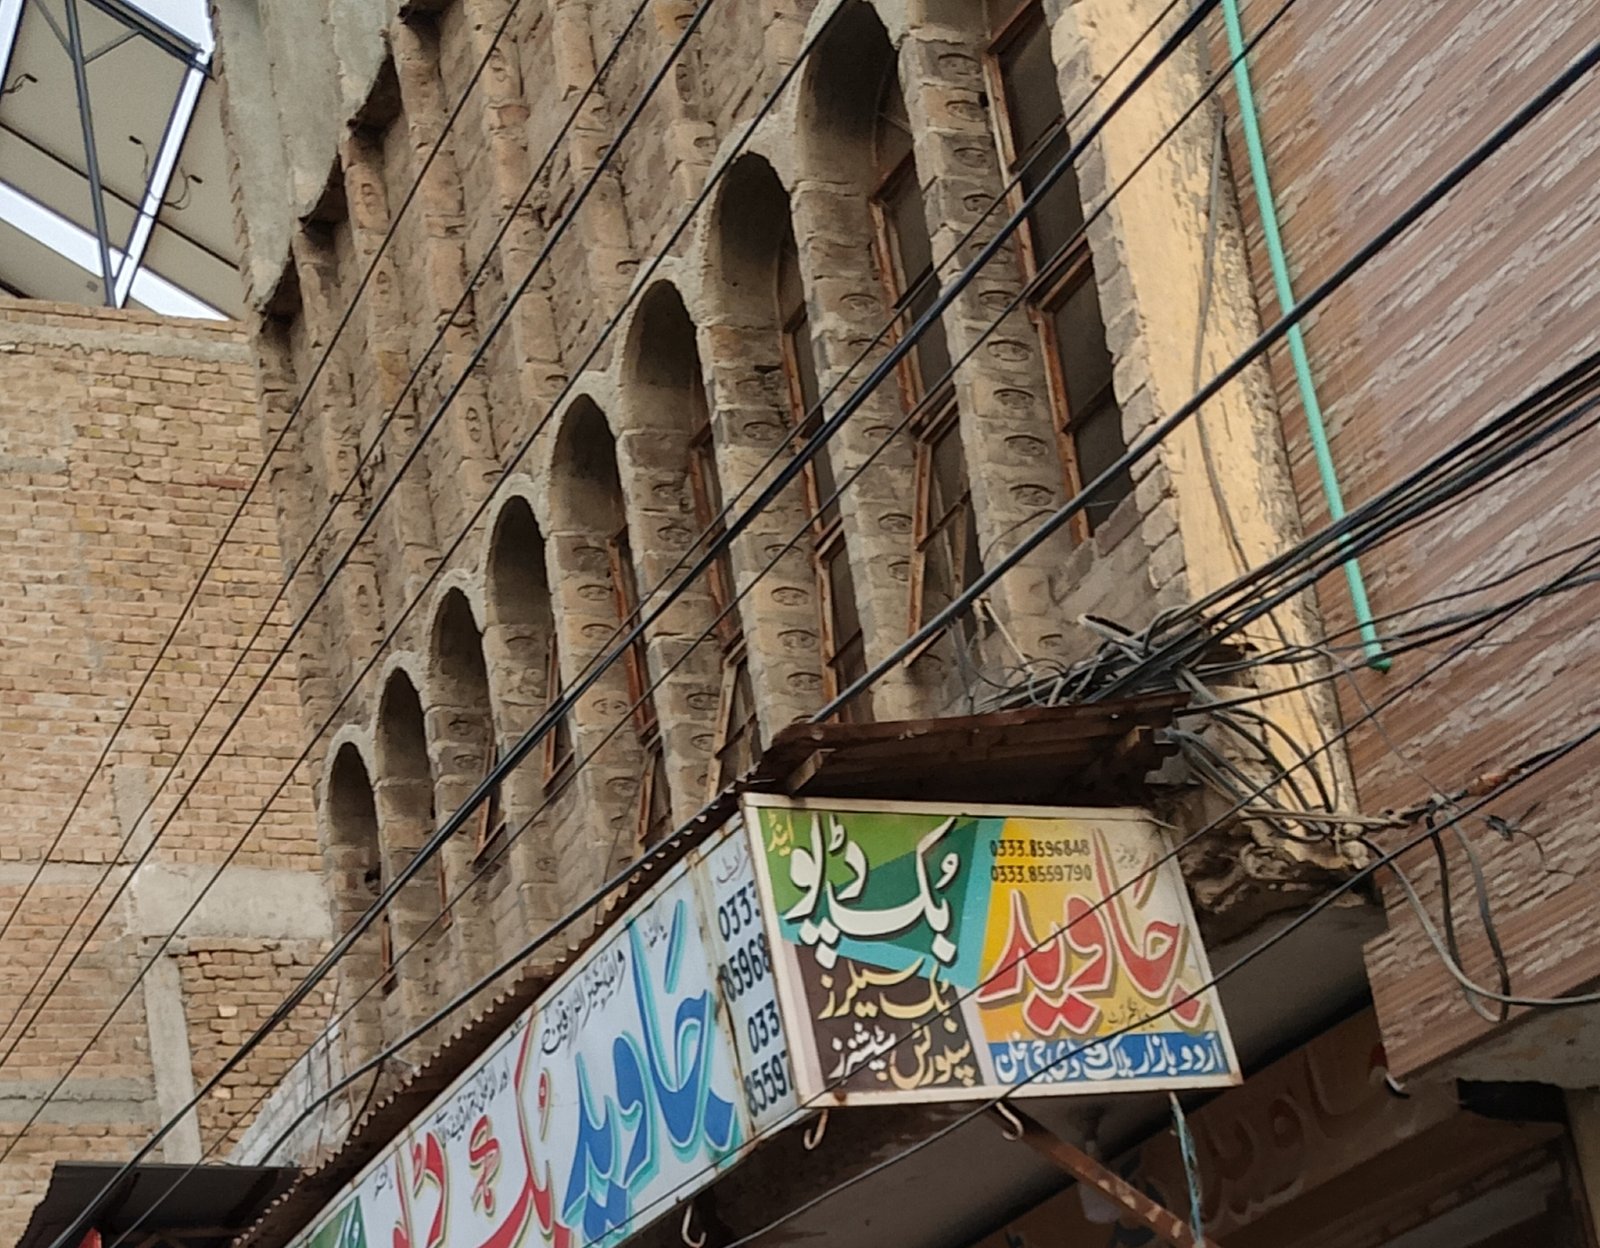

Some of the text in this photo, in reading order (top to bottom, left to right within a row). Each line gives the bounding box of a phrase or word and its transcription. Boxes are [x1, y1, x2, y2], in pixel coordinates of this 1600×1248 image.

[782, 812, 868, 969] ڈپو
[976, 828, 1203, 1036] جاوید
[817, 956, 925, 1020] سیلرز
[1134, 1034, 1177, 1075] بازار
